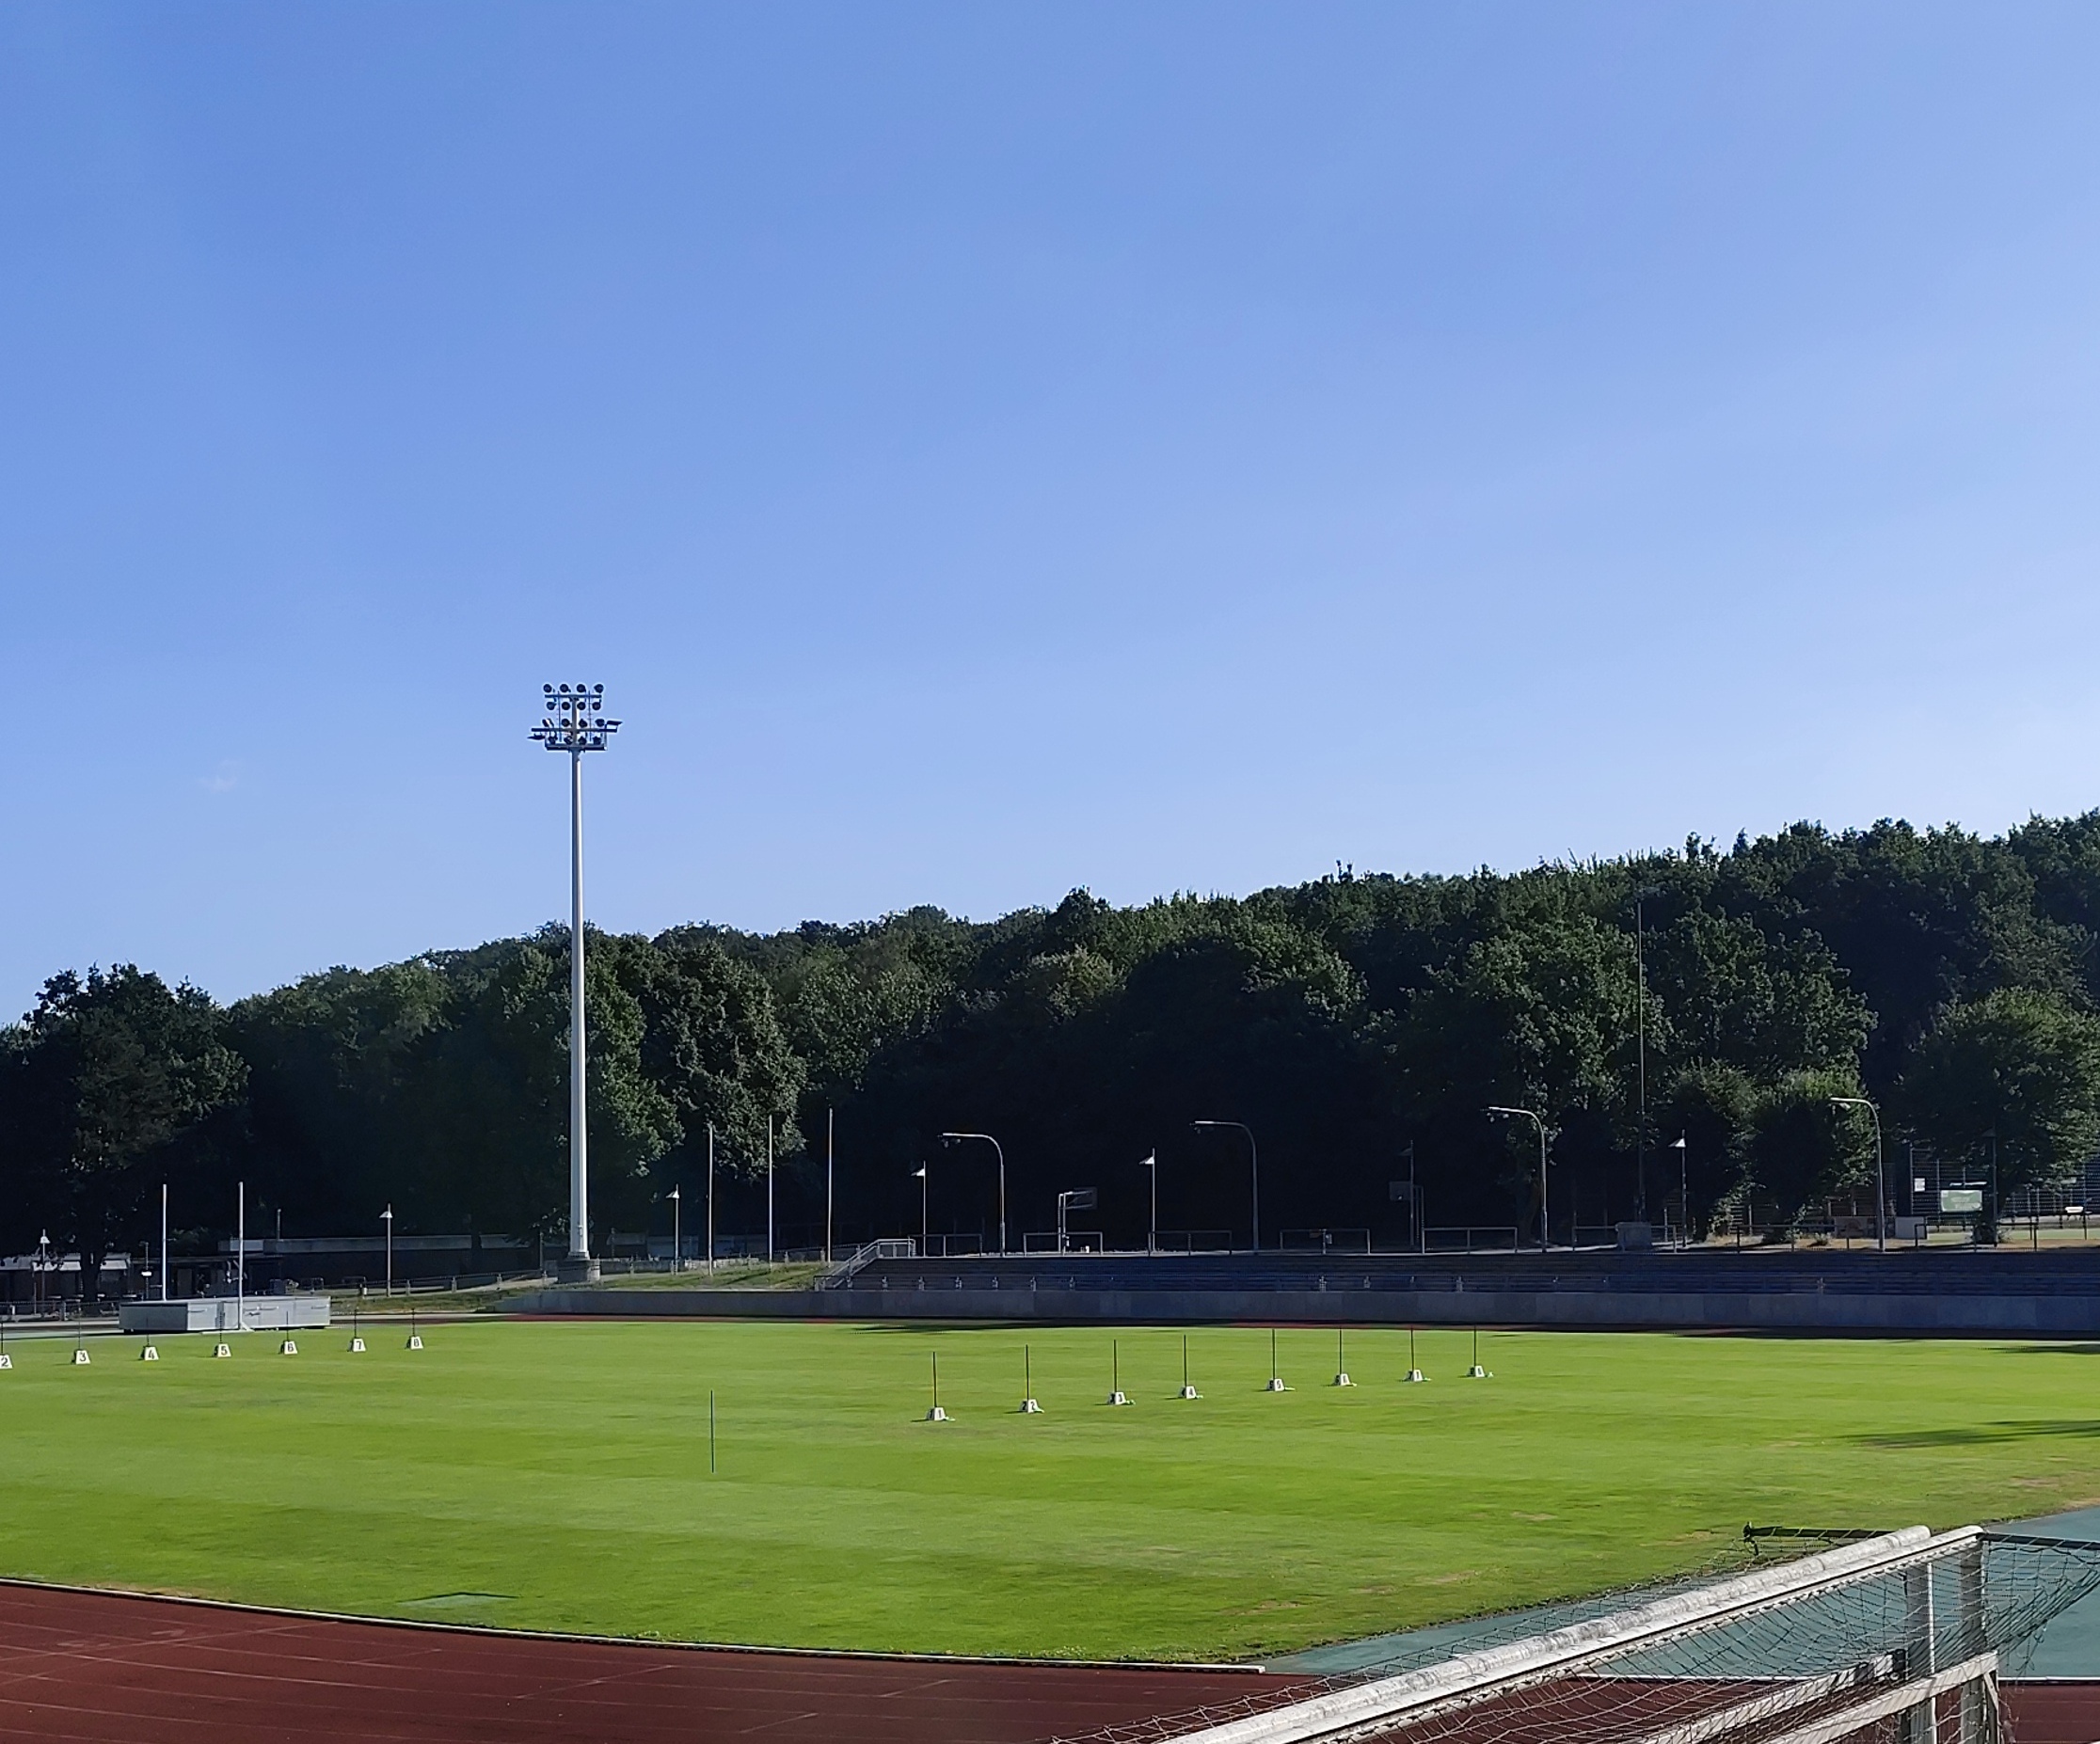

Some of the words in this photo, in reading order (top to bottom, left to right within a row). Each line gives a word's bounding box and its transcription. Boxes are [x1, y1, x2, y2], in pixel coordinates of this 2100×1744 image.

[221, 1345, 228, 1356] 5
[357, 1340, 362, 1351] 7
[79, 1352, 87, 1362] 3
[148, 1350, 155, 1360] 4
[1, 1356, 8, 1368] 2
[1030, 1401, 1036, 1411] 2
